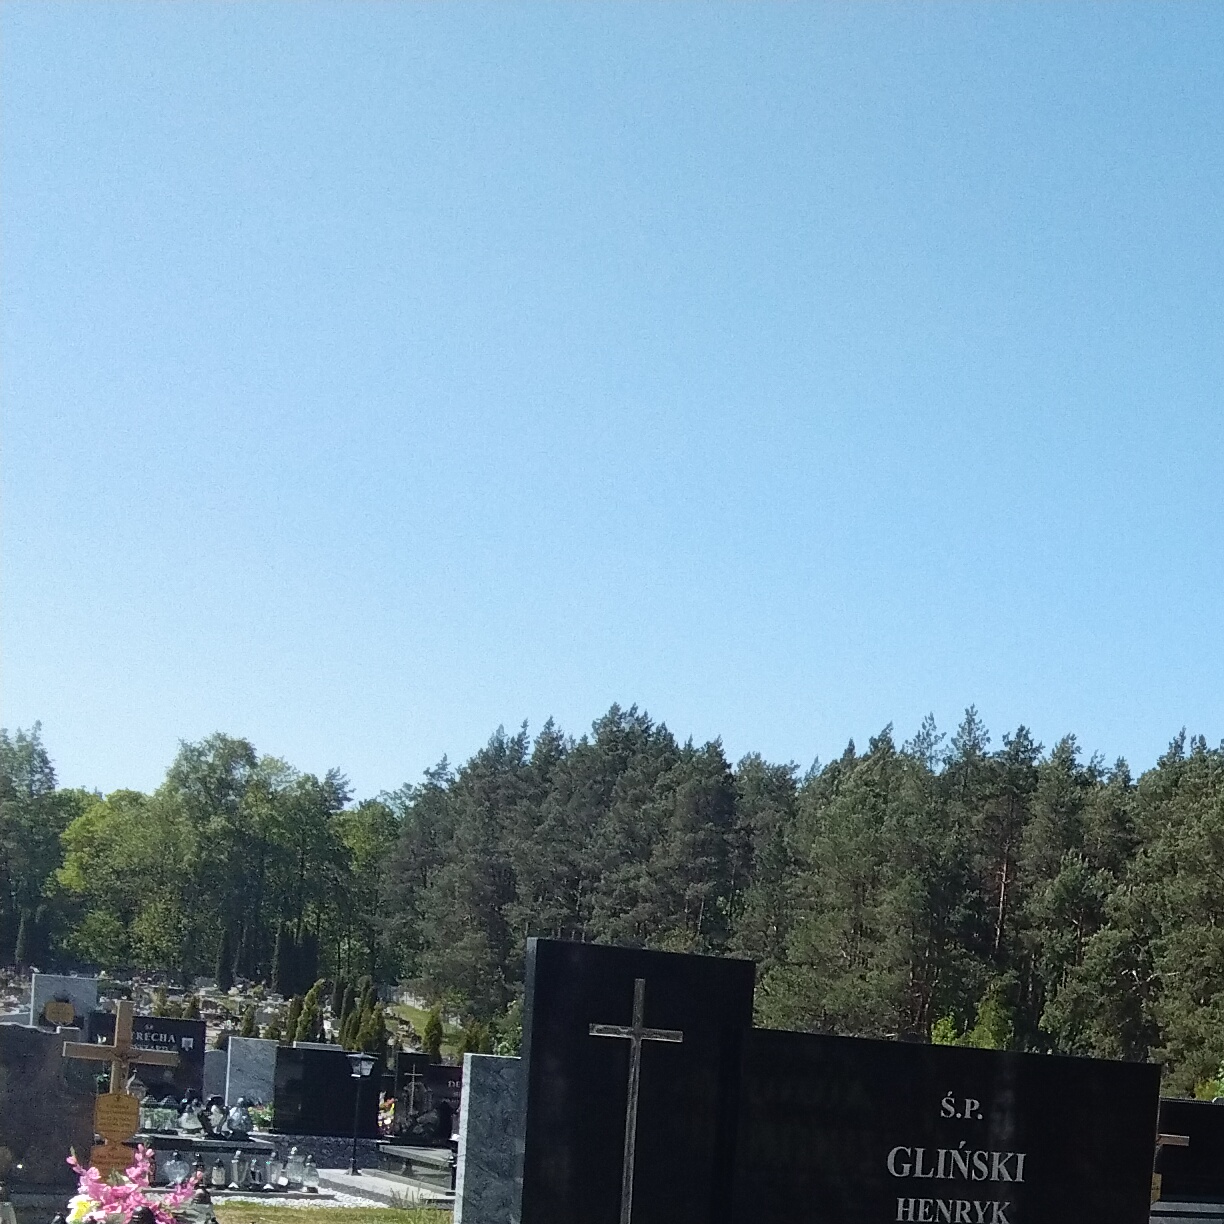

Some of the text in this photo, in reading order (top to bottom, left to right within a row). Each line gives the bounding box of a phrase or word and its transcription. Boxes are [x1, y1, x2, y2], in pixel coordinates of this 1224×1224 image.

[940, 1091, 984, 1120] Ś.P.
[887, 1141, 1027, 1183] GLIŃSKI
[896, 1198, 1011, 1224] HENRYK
